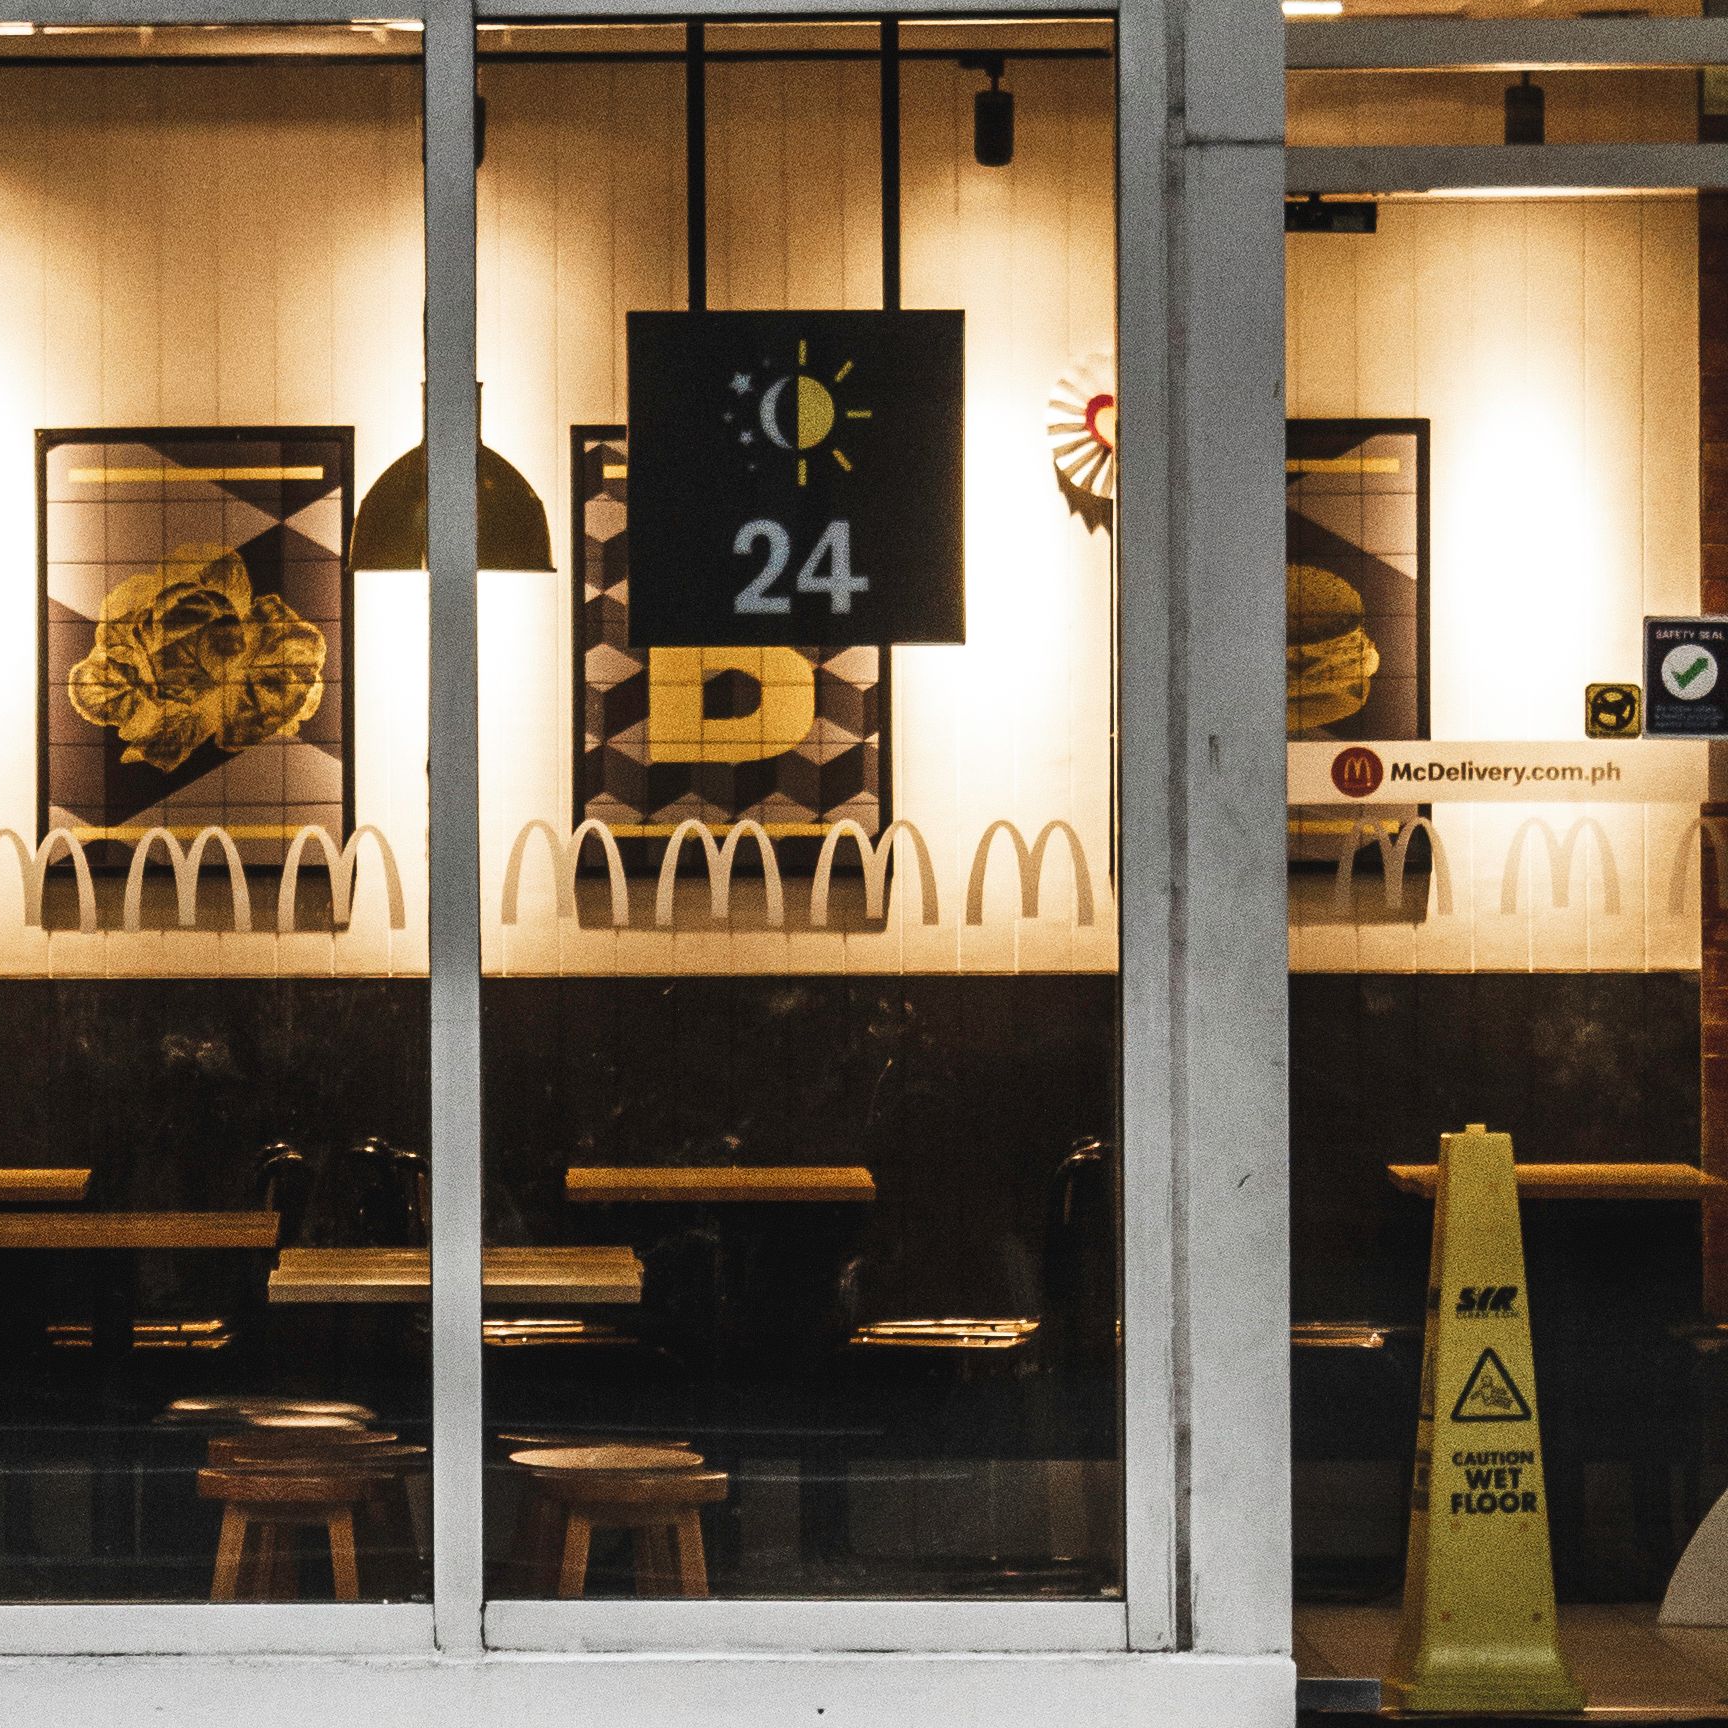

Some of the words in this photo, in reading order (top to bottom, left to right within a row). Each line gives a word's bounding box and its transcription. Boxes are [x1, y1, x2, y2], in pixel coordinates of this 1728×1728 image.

[733, 519, 870, 614] 24
[1655, 629, 1695, 640] SAFETY
[1699, 630, 1726, 641] SEAL
[1390, 760, 1622, 786] McDelivery.com.ph
[1456, 1286, 1518, 1312] SIR
[1453, 1451, 1534, 1466] CAUTION
[1464, 1467, 1522, 1490] WET
[1450, 1492, 1537, 1515] FLOOR
